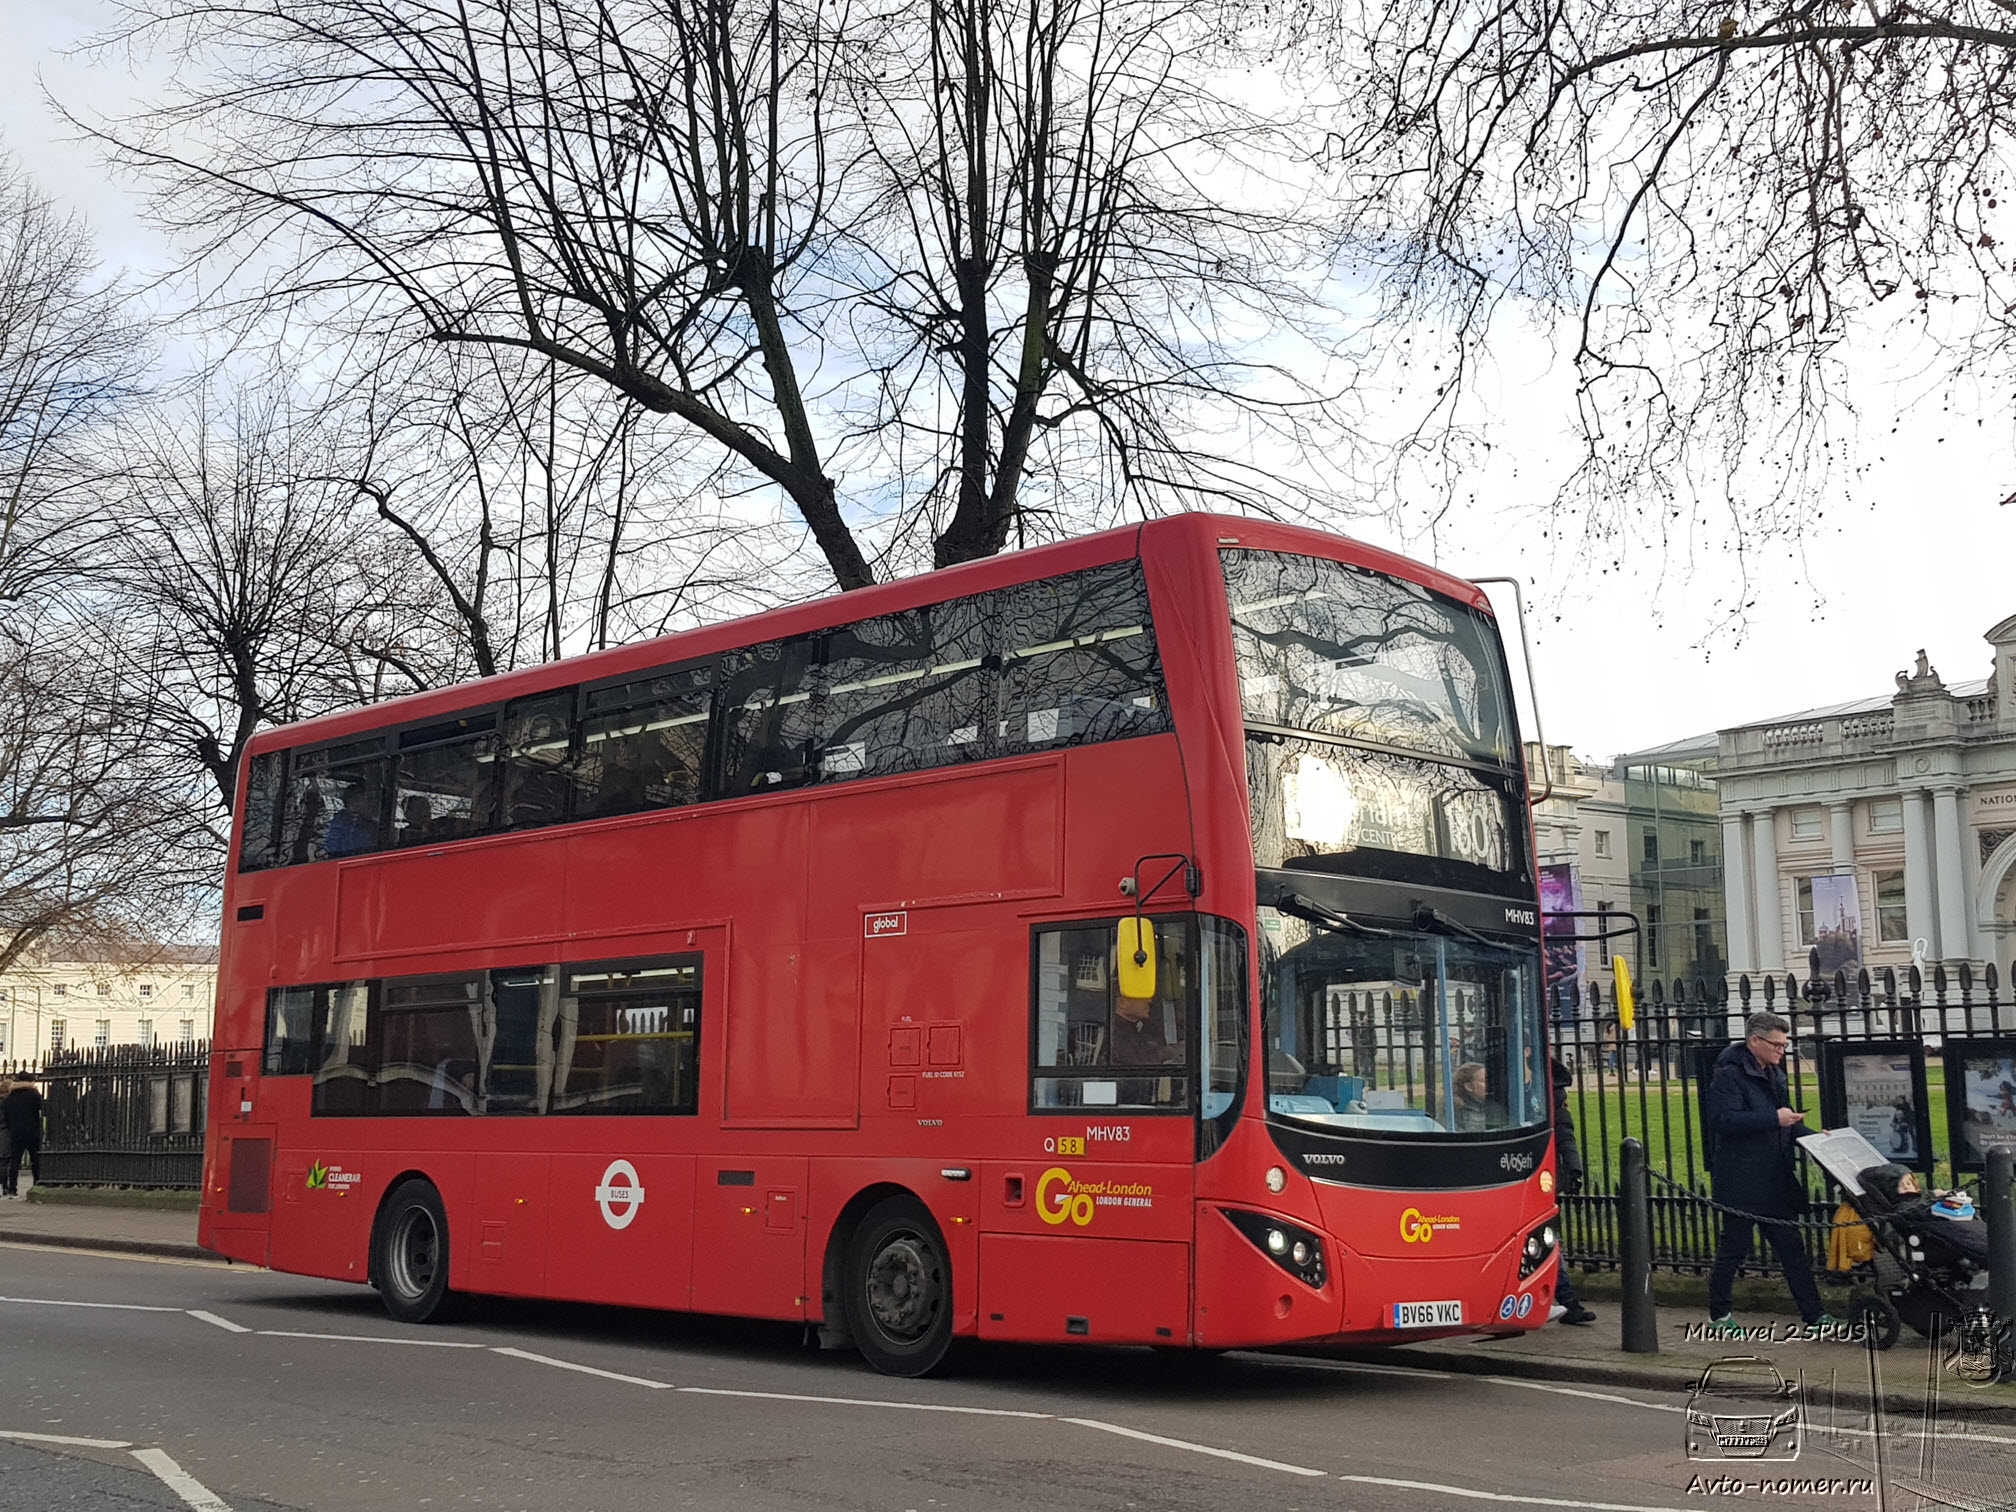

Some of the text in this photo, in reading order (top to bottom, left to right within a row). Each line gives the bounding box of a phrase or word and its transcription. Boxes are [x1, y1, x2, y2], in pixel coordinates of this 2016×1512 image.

[1980, 795, 2016, 805] NATIO
[873, 915, 898, 933] global
[1505, 908, 1534, 925] MHV83
[1086, 1126, 1130, 1141] MHV83
[1044, 1137, 1055, 1152] Q
[1302, 1154, 1345, 1164] VOLVO
[610, 1190, 629, 1199] BUSES
[1036, 1167, 1152, 1226] Go Ahead-London
[1096, 1196, 1152, 1207] LONDON GENERAL
[1400, 1207, 1432, 1243] Go
[1402, 1303, 1460, 1324] BV66 VKC
